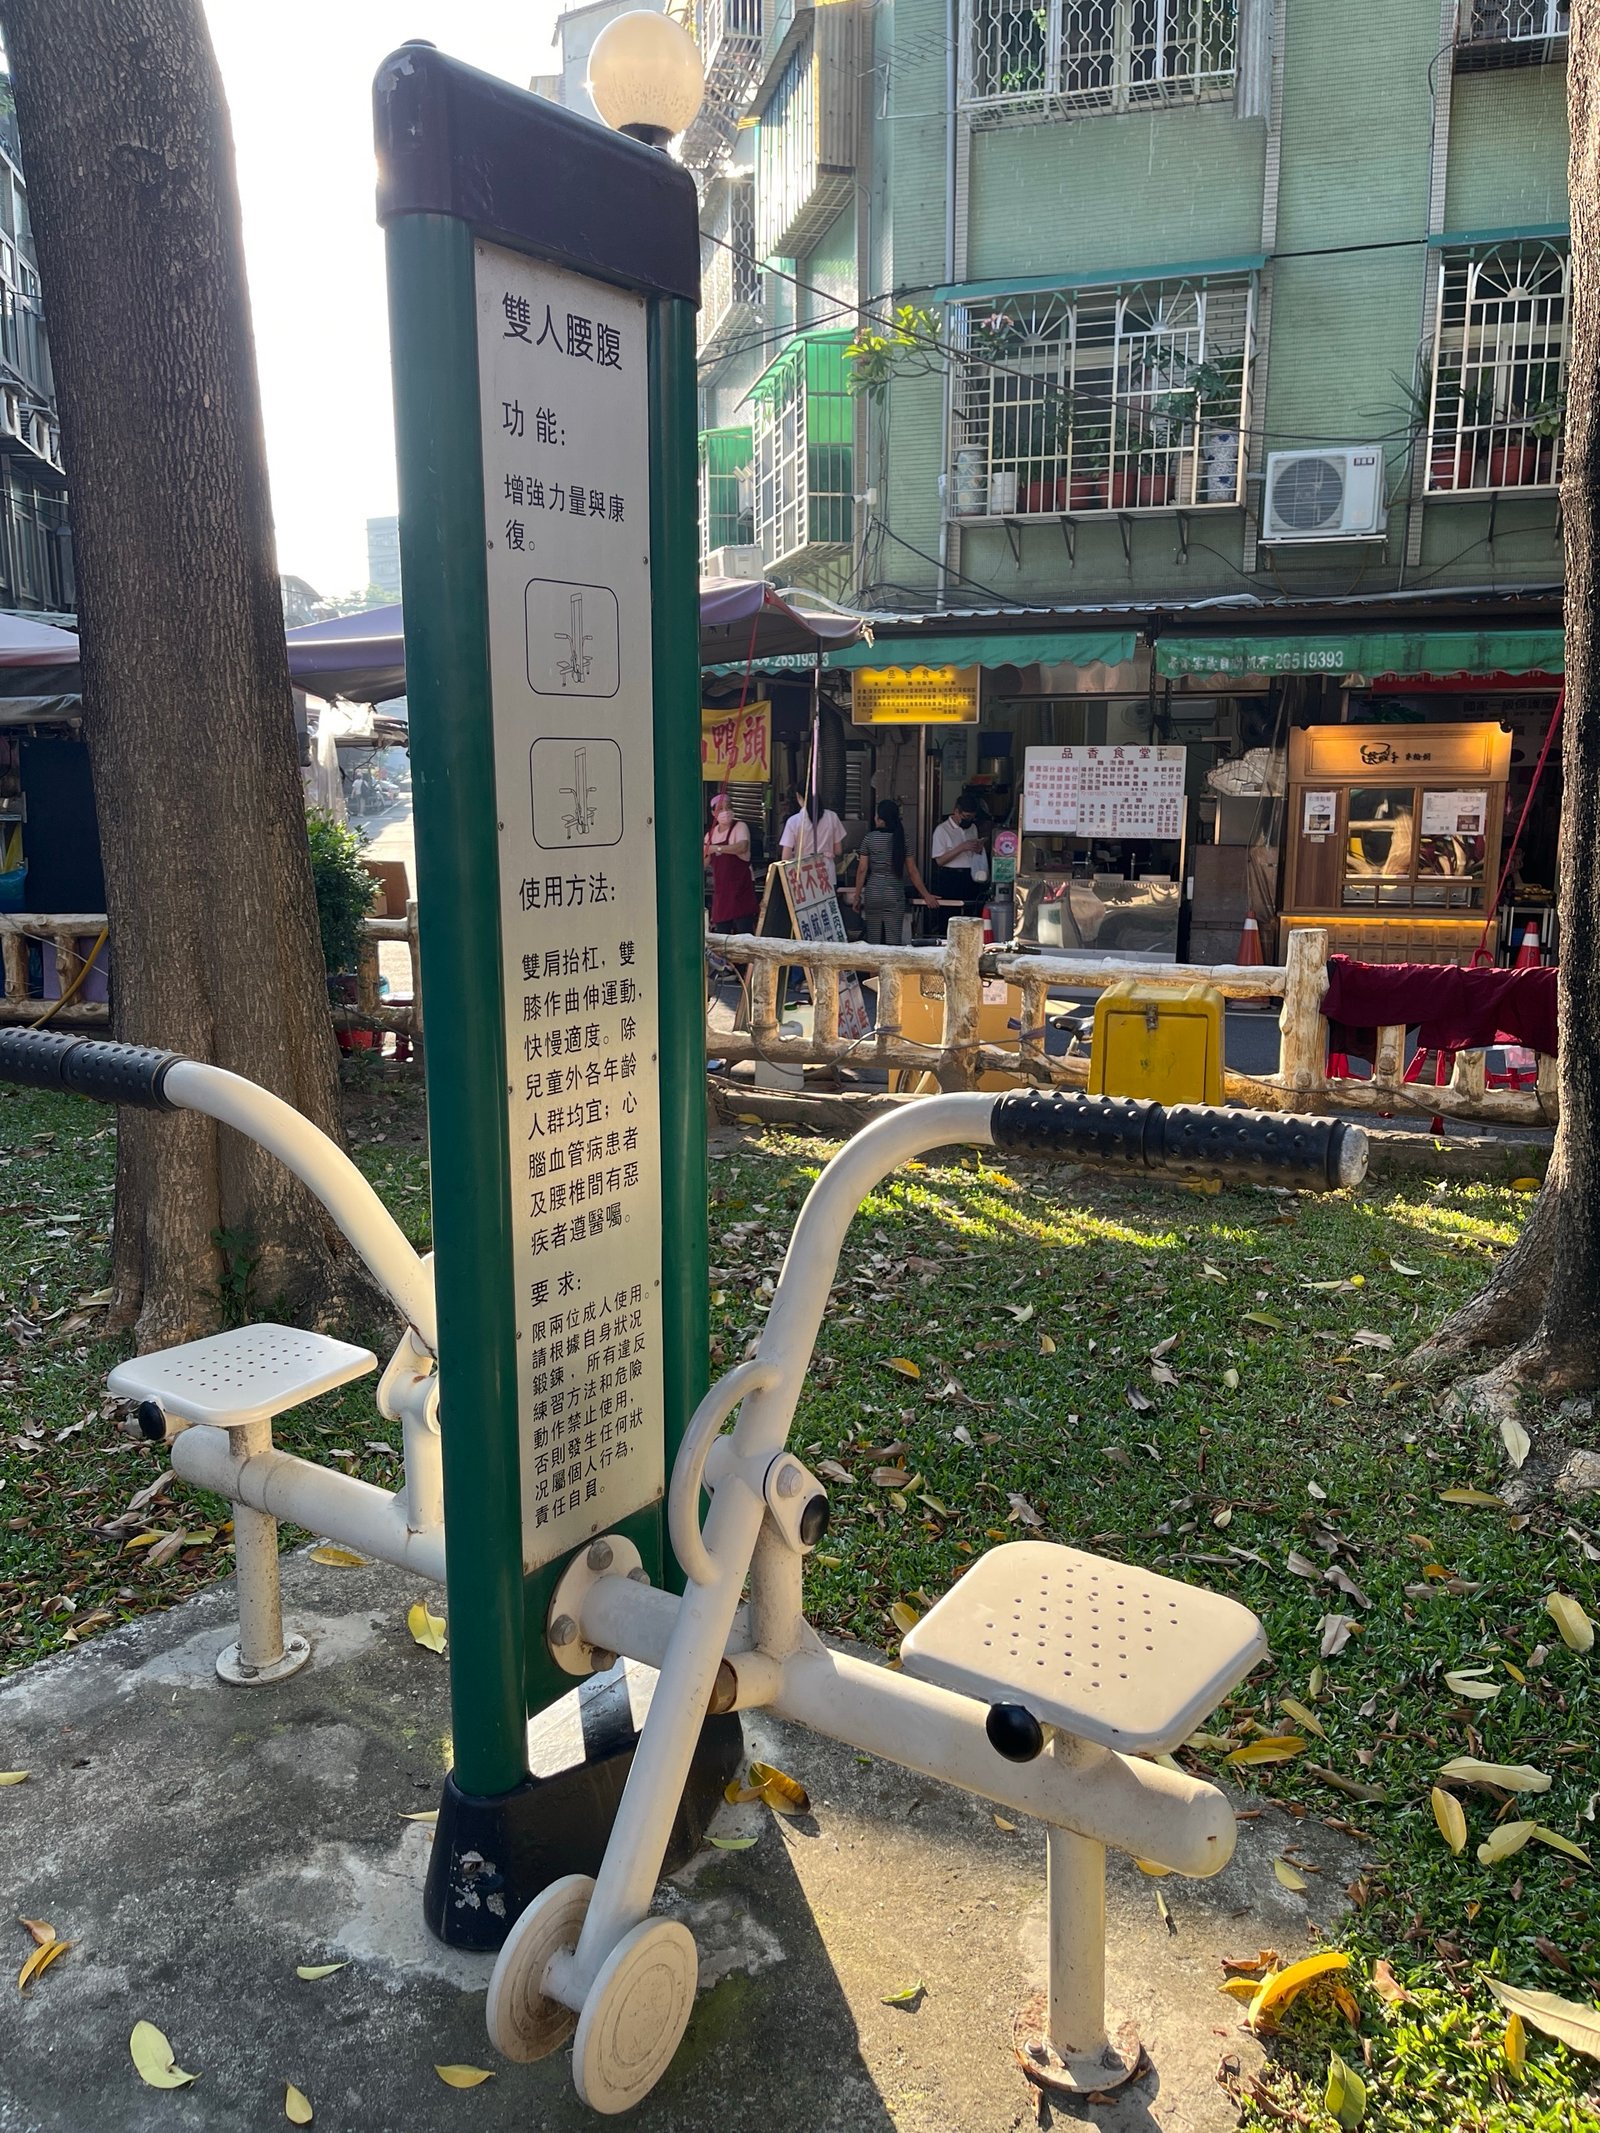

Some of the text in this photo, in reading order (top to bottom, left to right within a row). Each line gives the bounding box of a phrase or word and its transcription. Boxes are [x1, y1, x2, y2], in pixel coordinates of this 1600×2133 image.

[502, 292, 623, 371] 雙人腰腹
[503, 473, 625, 522] 增強力量與康
[505, 519, 536, 551] 復。
[702, 716, 768, 770] 鴨頭
[1062, 747, 1151, 759] 品香食堂
[518, 871, 616, 912] 使用方法：
[523, 977, 642, 1021] 膝作曲伸運動，
[524, 1015, 637, 1062] 快慢適度。除
[526, 1051, 637, 1101] 兒童外各年齡
[528, 1090, 638, 1141] 人群均宜；心
[528, 1126, 639, 1179] 腦血管病患者
[529, 1160, 639, 1218] 及腰椎間有惡
[531, 1201, 631, 1256] 疾者遵醫囑。
[532, 1283, 650, 1344] 限兩位成人使用。
[533, 1359, 643, 1422] 練習方法和危險
[534, 1407, 643, 1477] 否則發生任何狀
